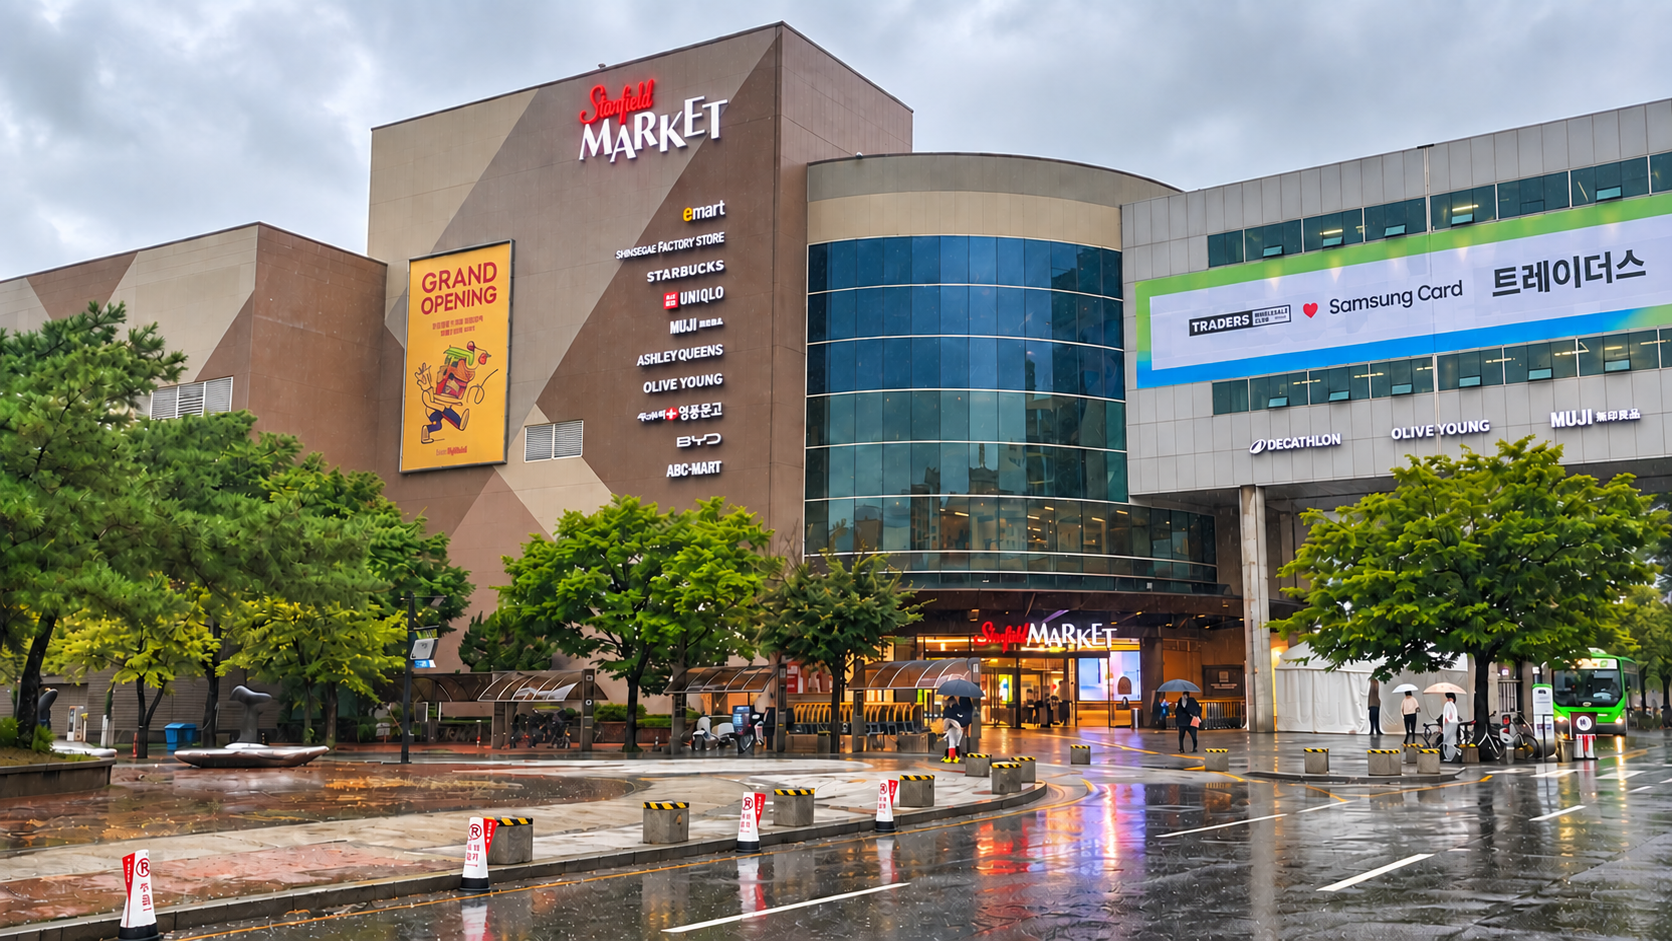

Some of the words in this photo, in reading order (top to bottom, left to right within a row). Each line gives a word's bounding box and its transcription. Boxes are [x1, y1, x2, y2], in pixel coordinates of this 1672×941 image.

[579, 79, 655, 125] Starfield
[578, 95, 728, 163] MARKET
[683, 200, 726, 222] emart
[658, 237, 695, 253] FACTORY
[696, 232, 725, 247] STORE
[421, 261, 498, 294] GRAND
[646, 260, 725, 283] STARBUCKS
[1492, 249, 1647, 298] 트레이더스
[420, 285, 498, 315] OPENING
[680, 286, 725, 306] UNIQLO
[1329, 288, 1413, 315] Samsung
[1417, 280, 1463, 301] Card
[670, 318, 698, 335] MUJI
[1192, 314, 1250, 334] TRADERS
[636, 349, 678, 367] ASHLEY
[678, 344, 724, 362] QUEENS
[643, 378, 678, 394] OLIVE
[680, 373, 724, 389] YOUNG
[1550, 408, 1594, 429] MUJI
[676, 433, 722, 447] BYD
[1391, 424, 1435, 440] OLIVE
[1437, 419, 1491, 436] YOUNG
[1267, 433, 1342, 451] DECATHLON
[666, 460, 722, 478] ABC-MART
[1026, 622, 1118, 649] MARKET
